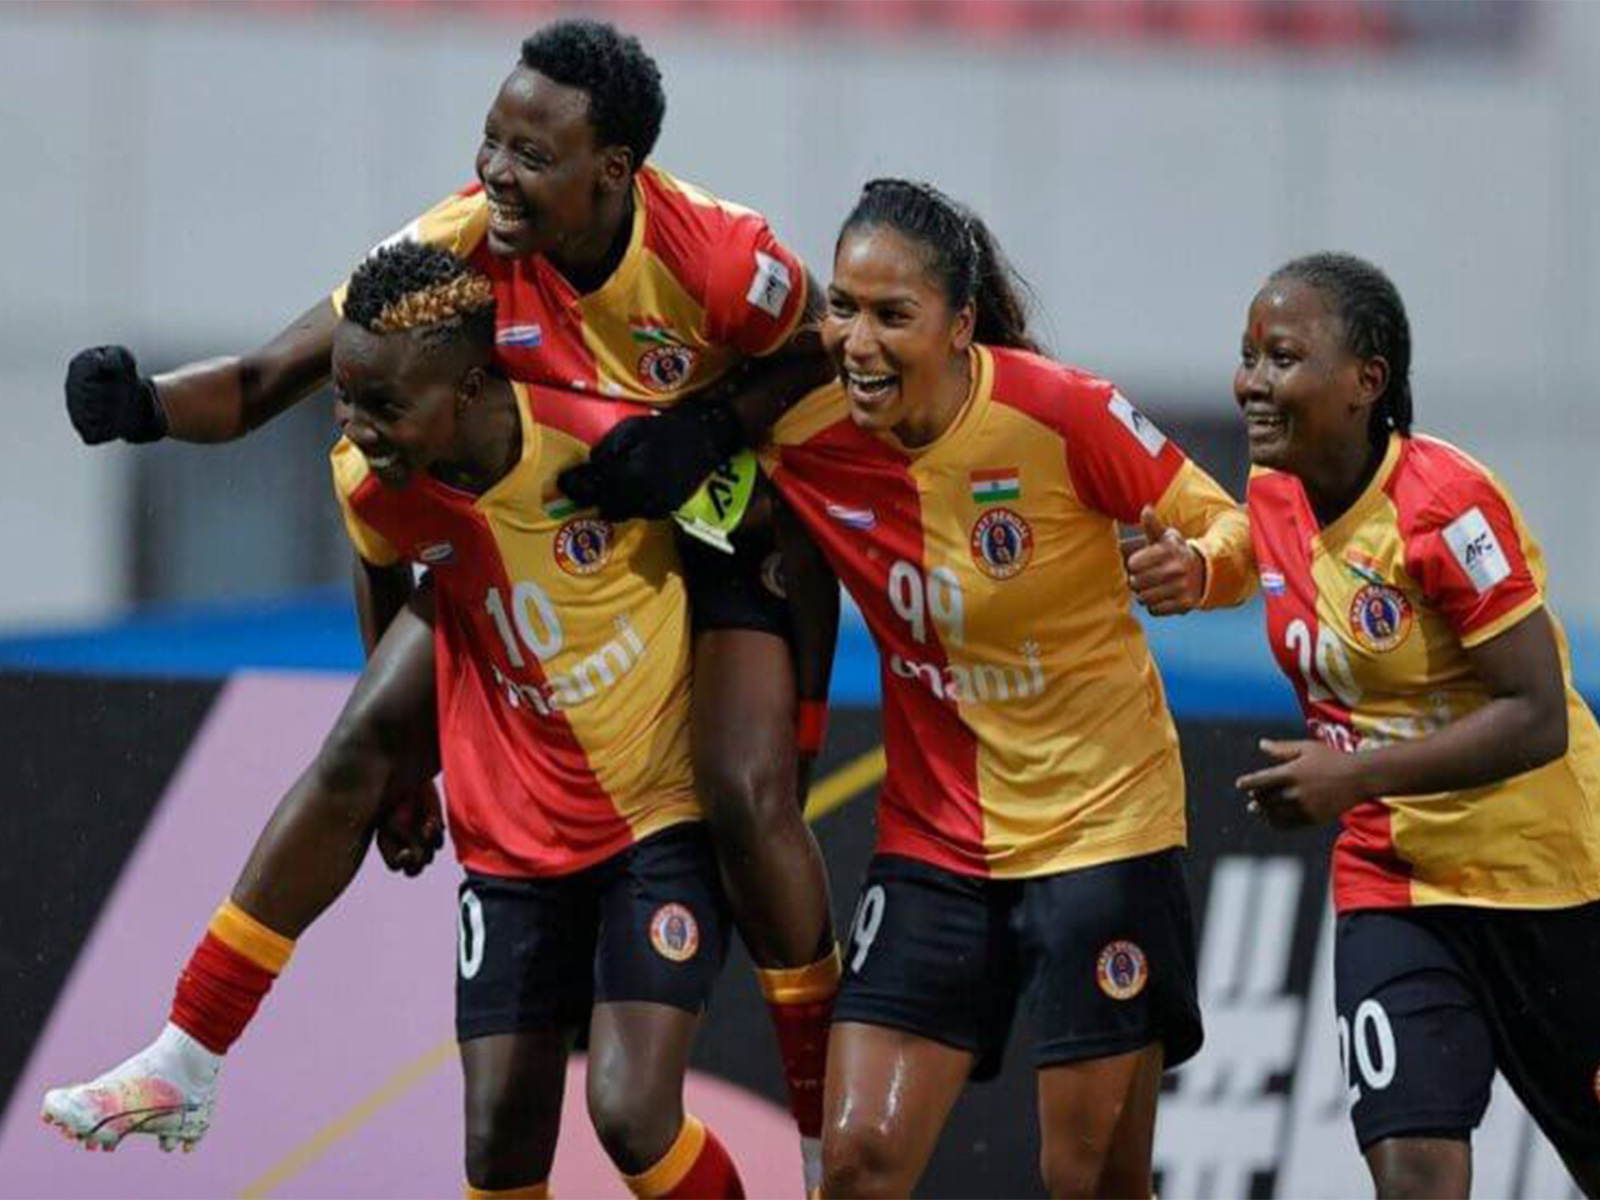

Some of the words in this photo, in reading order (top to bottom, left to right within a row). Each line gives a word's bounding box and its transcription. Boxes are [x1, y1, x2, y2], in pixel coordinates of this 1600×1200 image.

[484, 580, 563, 669] 10
[888, 560, 965, 645] 99
[1284, 618, 1358, 707] 20
